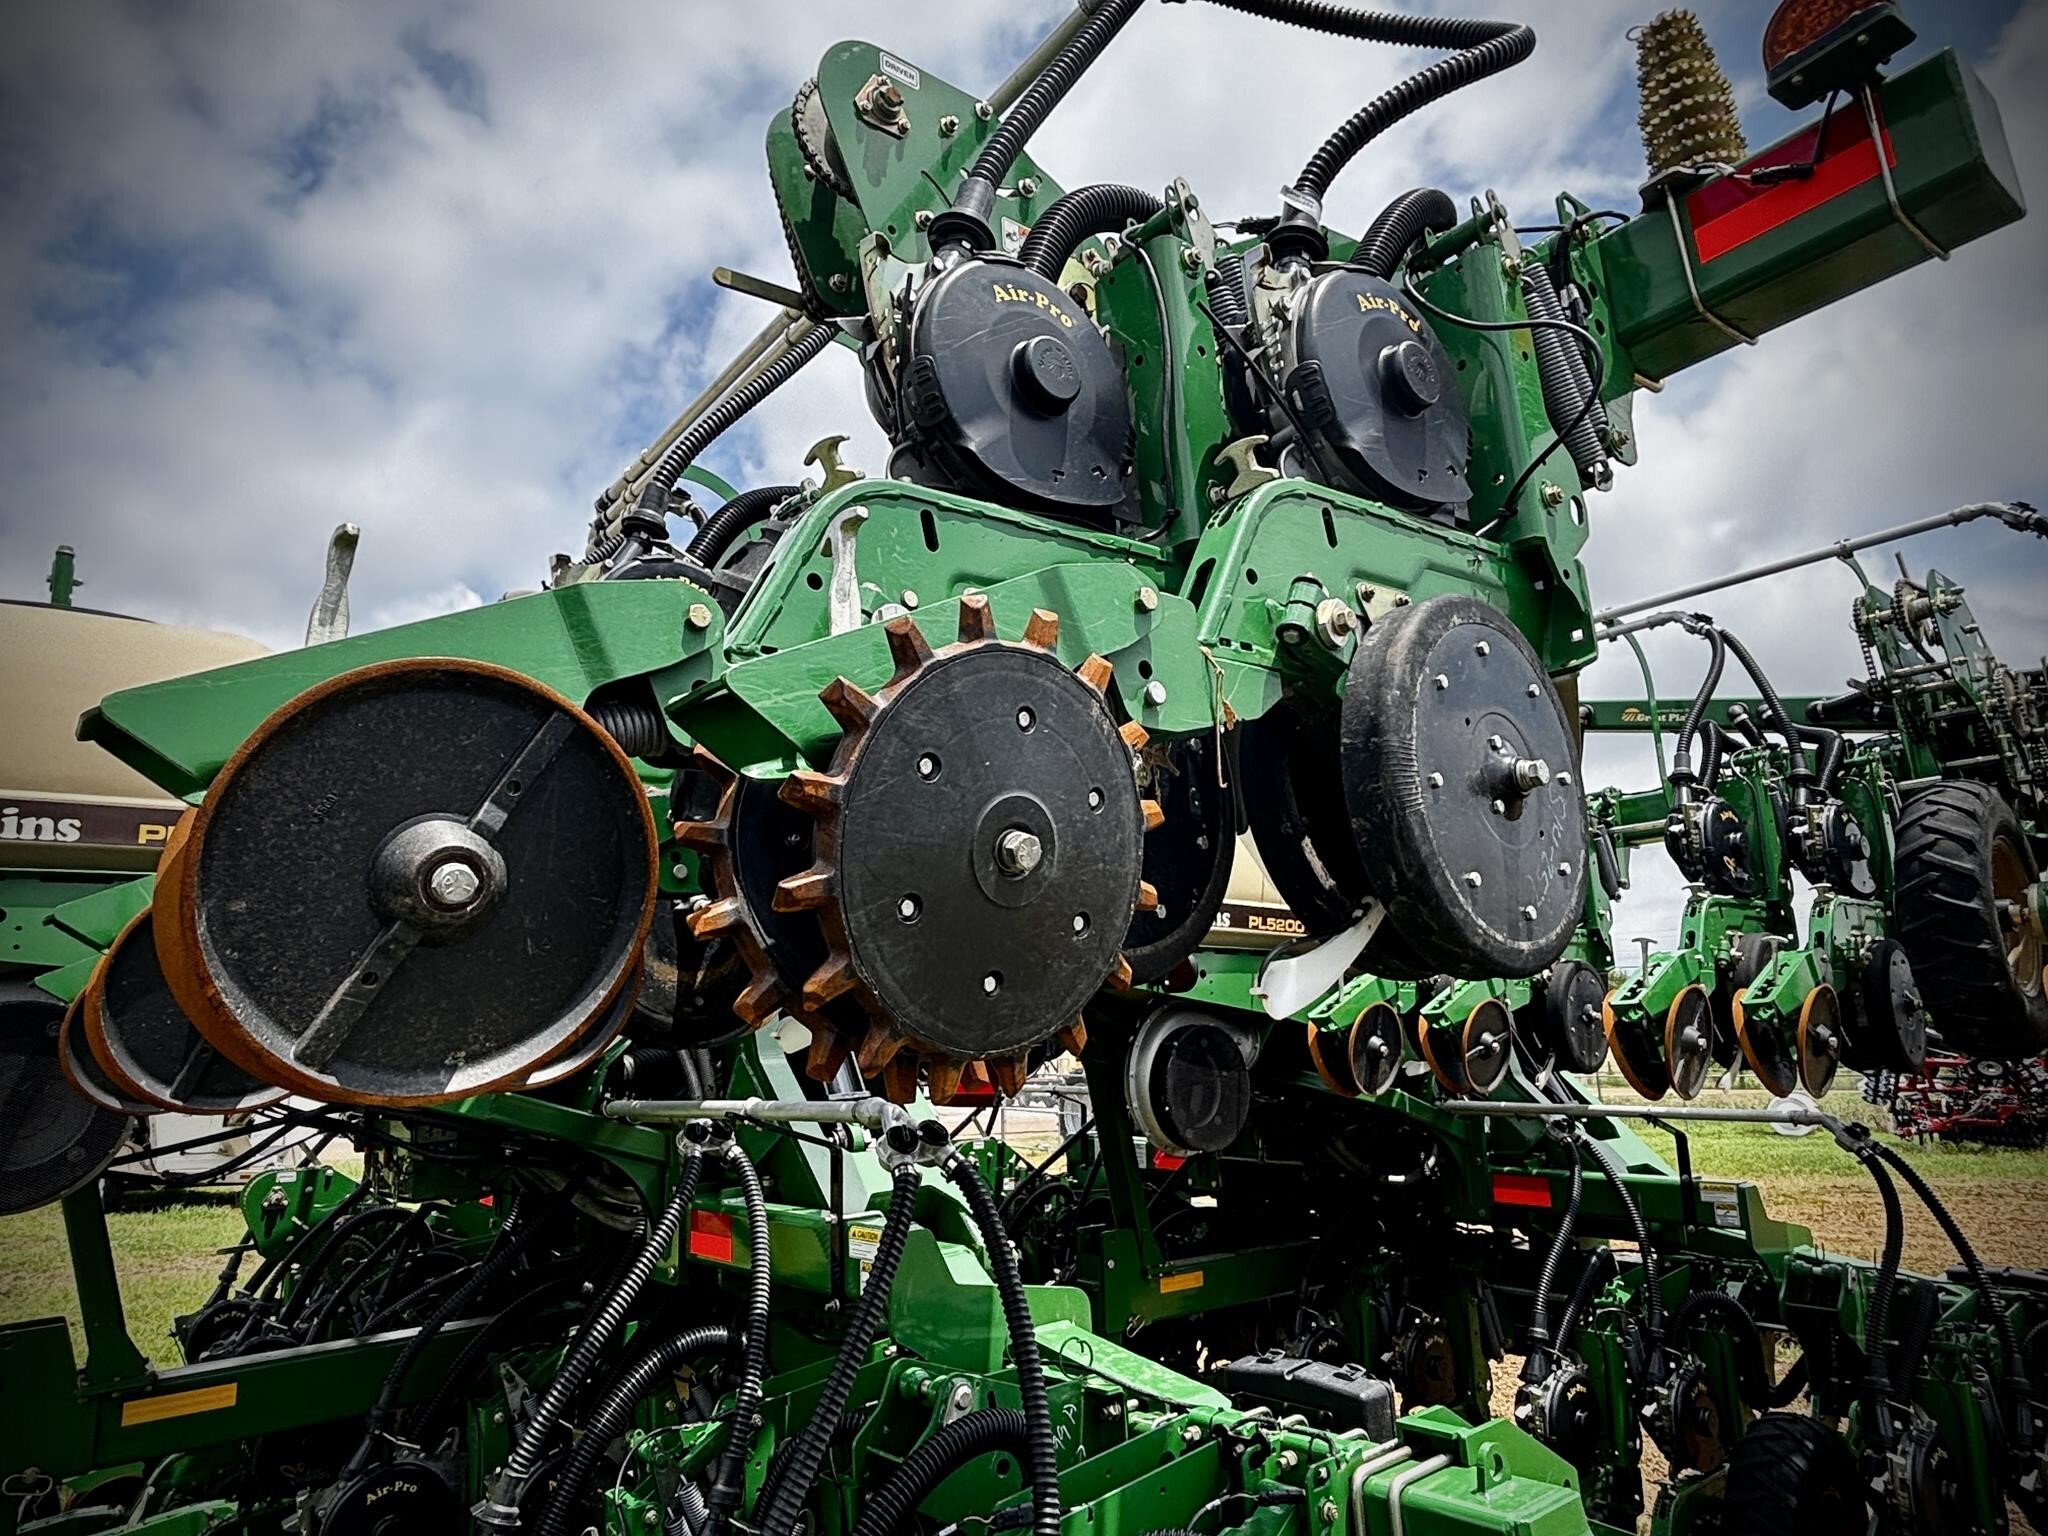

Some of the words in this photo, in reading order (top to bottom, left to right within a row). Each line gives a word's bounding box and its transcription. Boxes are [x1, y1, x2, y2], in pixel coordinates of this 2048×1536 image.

[884, 60, 915, 80] DRIVEN
[992, 283, 1073, 328] Air-Pro
[1356, 292, 1420, 332] Air-Pro
[1248, 915, 1305, 933] PL5200
[857, 1230, 878, 1240] CAUTION
[366, 1480, 418, 1506] Air-Pro
